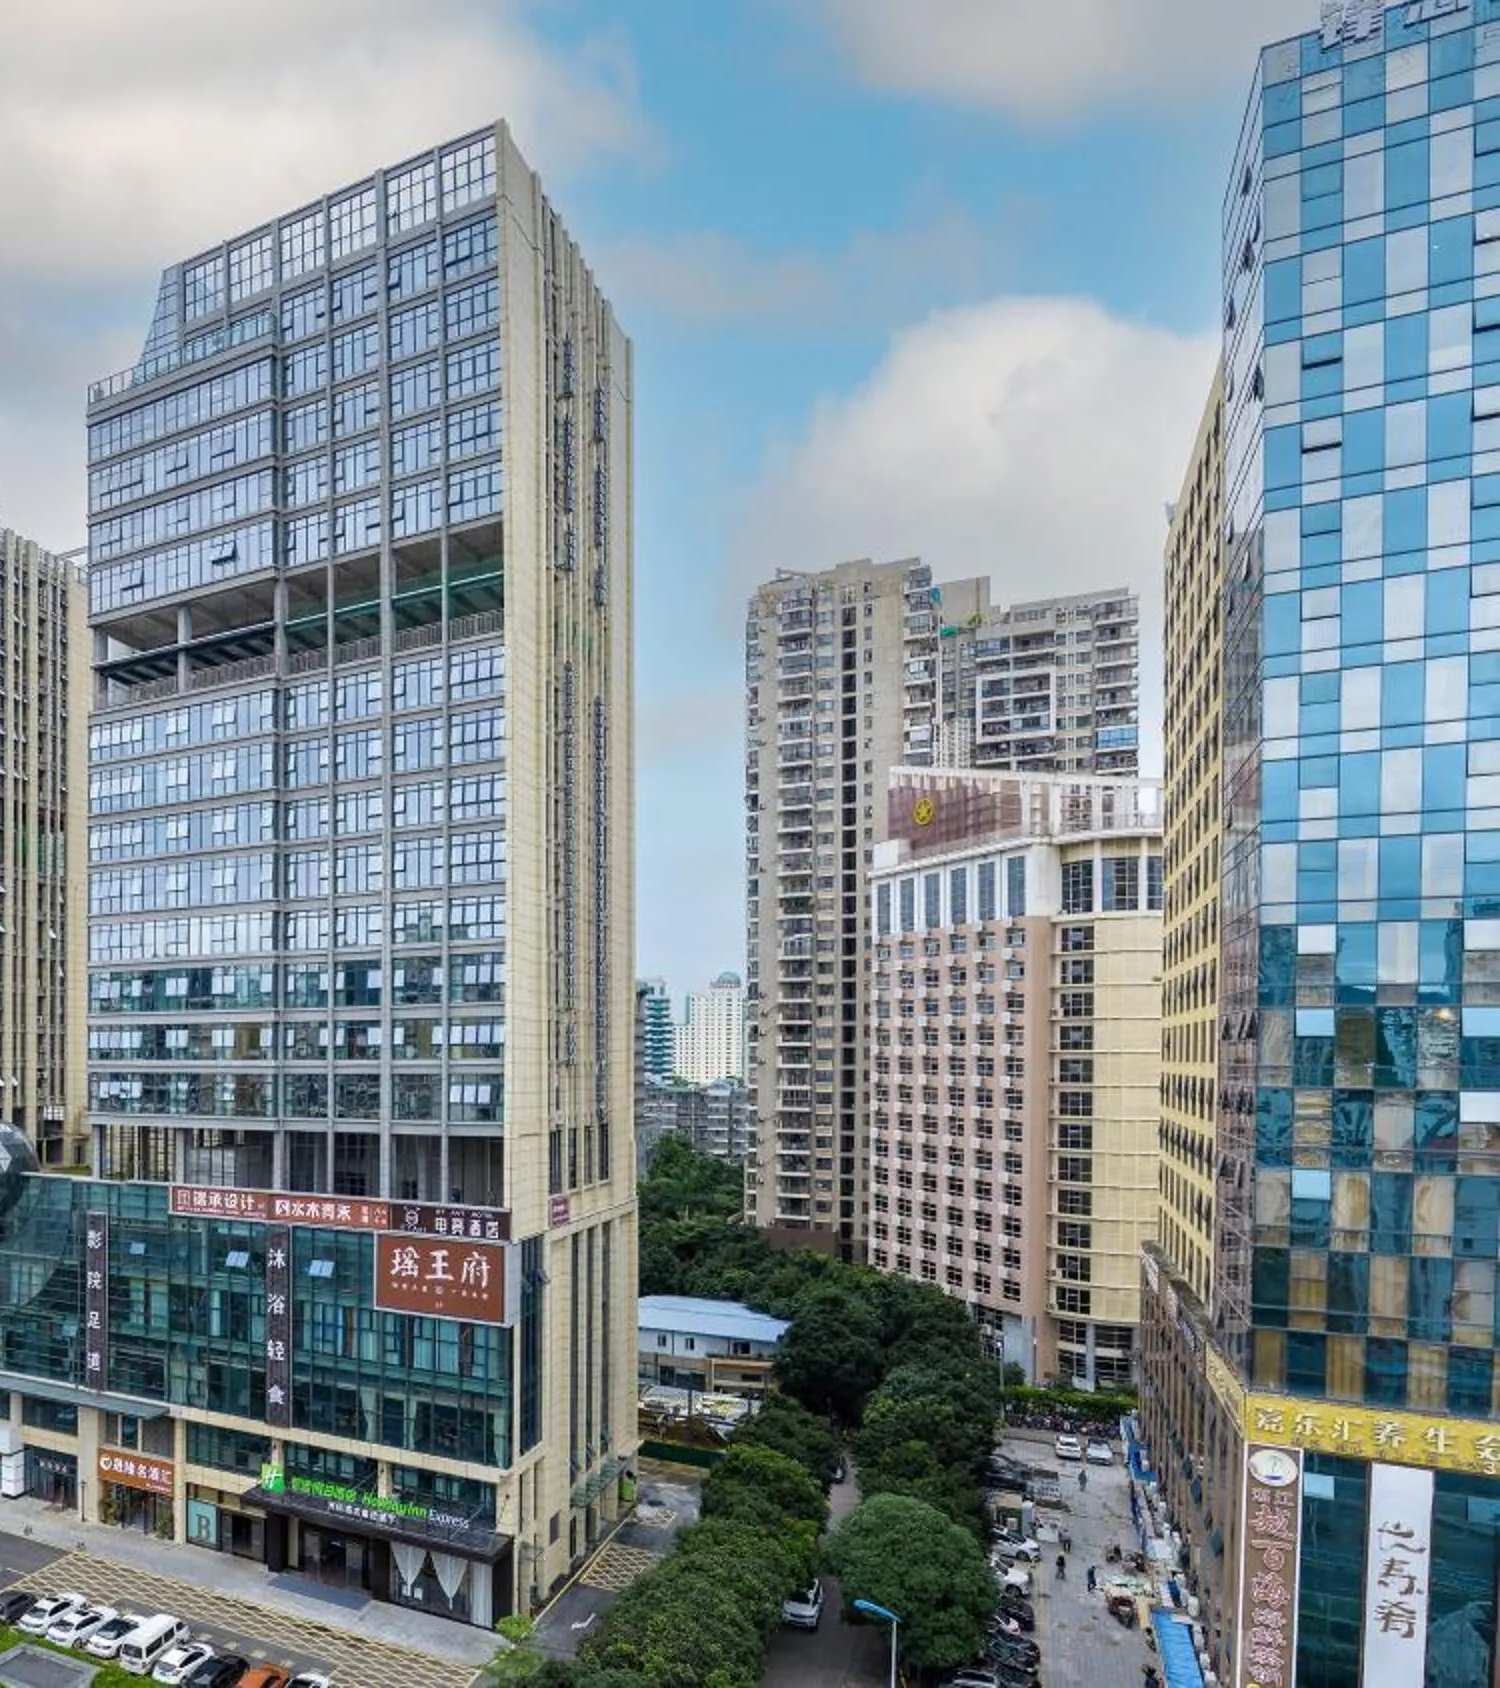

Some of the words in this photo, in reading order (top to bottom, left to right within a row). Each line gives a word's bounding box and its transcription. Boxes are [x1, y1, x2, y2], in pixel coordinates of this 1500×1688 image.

[86, 1230, 103, 1372] 影院足道
[390, 1245, 491, 1289] 瑶王府
[267, 1248, 286, 1405] 沐浴轻食
[428, 1508, 470, 1529] Express
